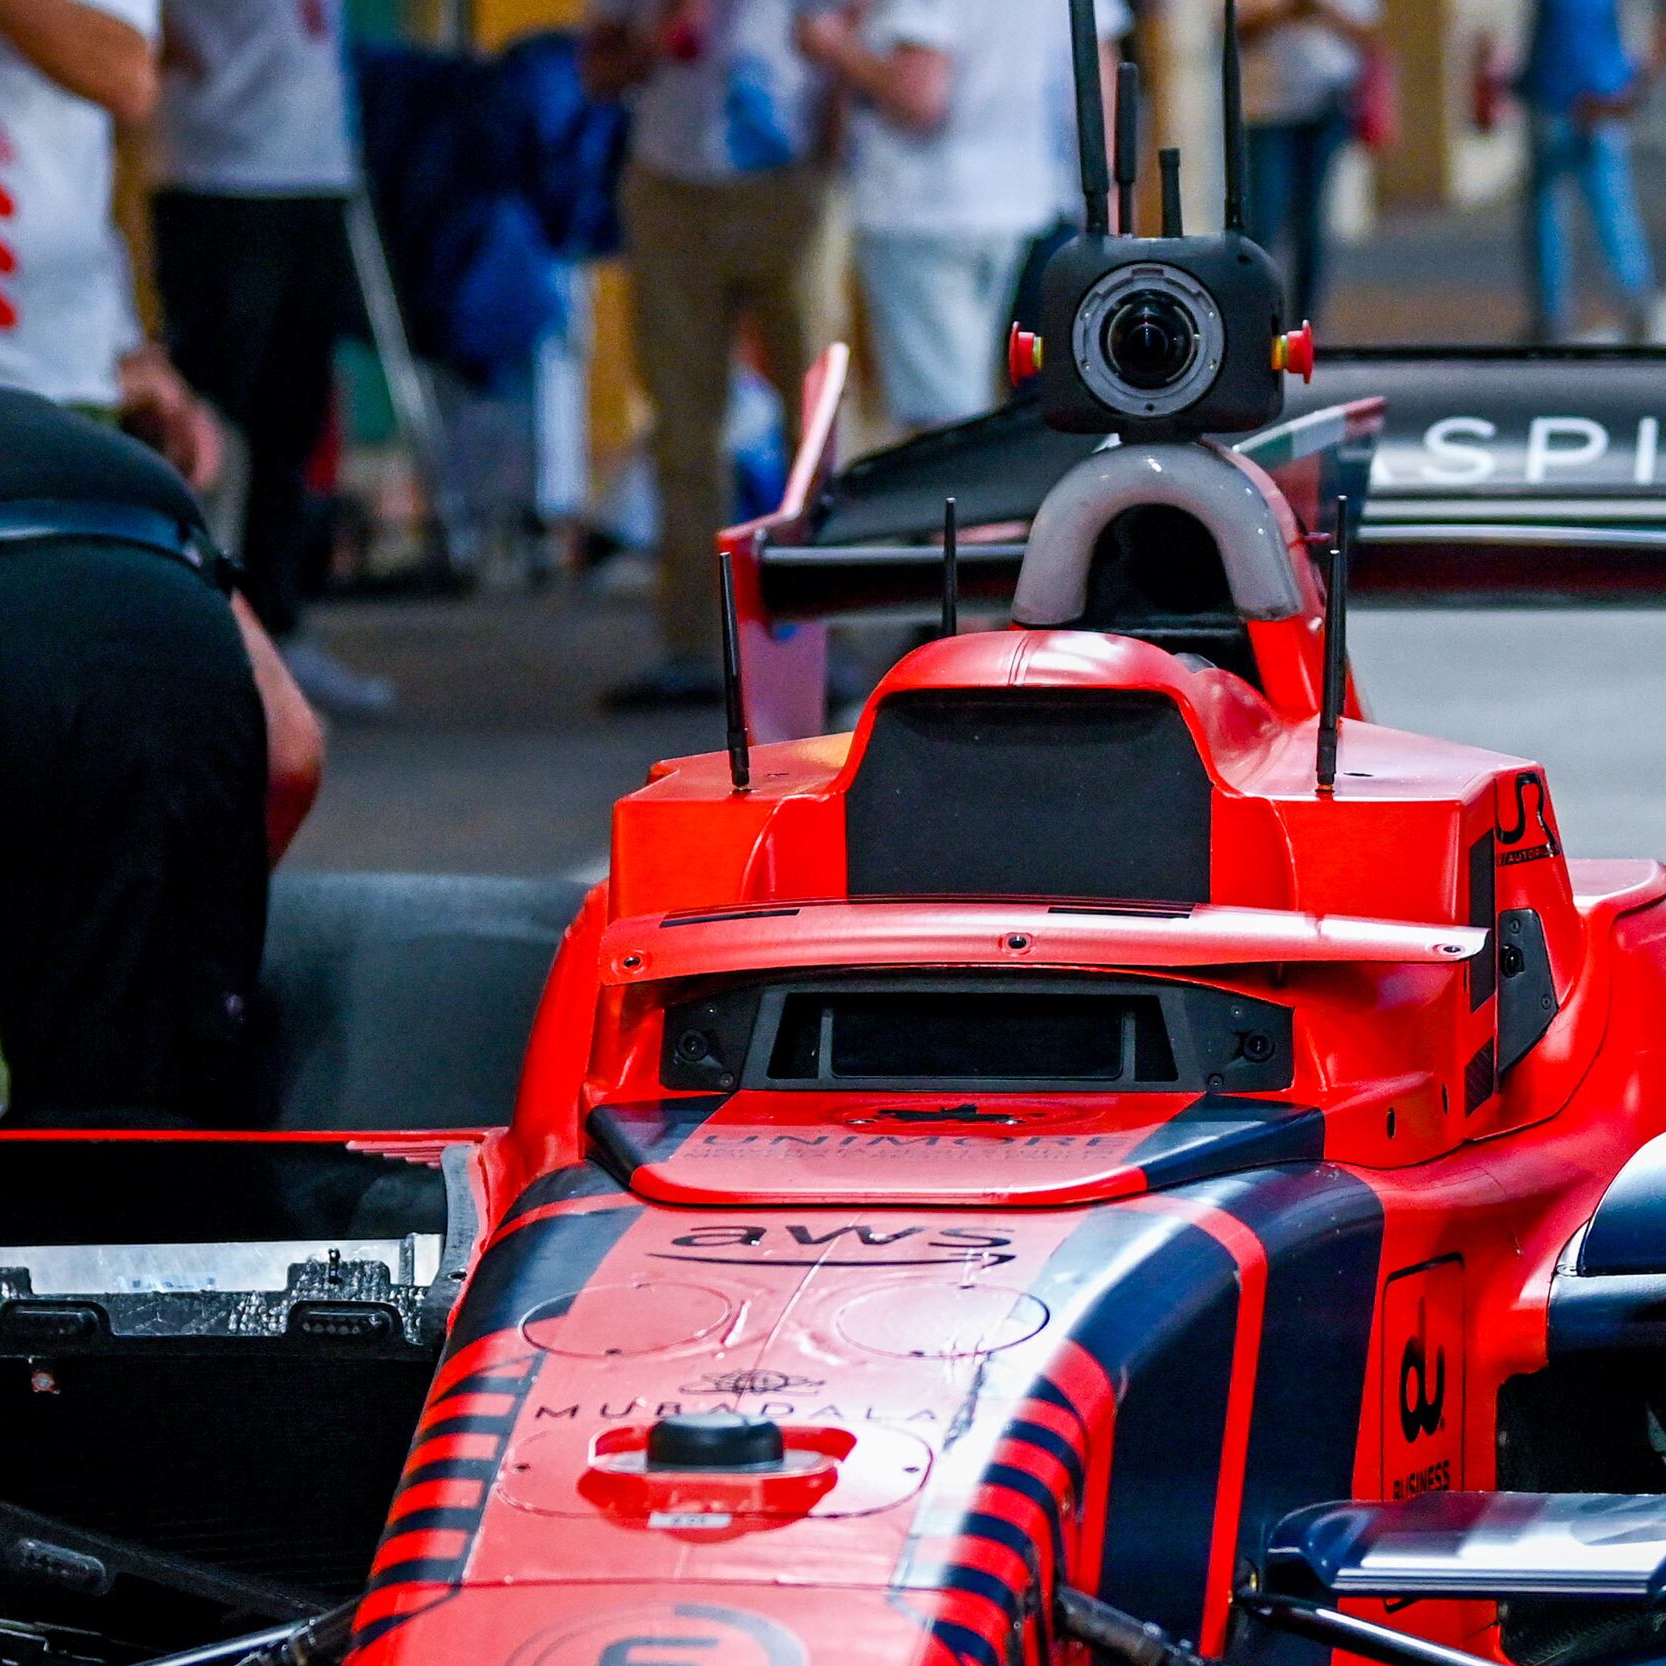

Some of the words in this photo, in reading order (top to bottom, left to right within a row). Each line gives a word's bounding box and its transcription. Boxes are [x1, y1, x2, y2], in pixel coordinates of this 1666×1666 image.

[701, 1134, 1131, 1148] UNIMORE
[670, 1223, 1017, 1249] aws
[534, 1402, 939, 1421] MUBADALA
